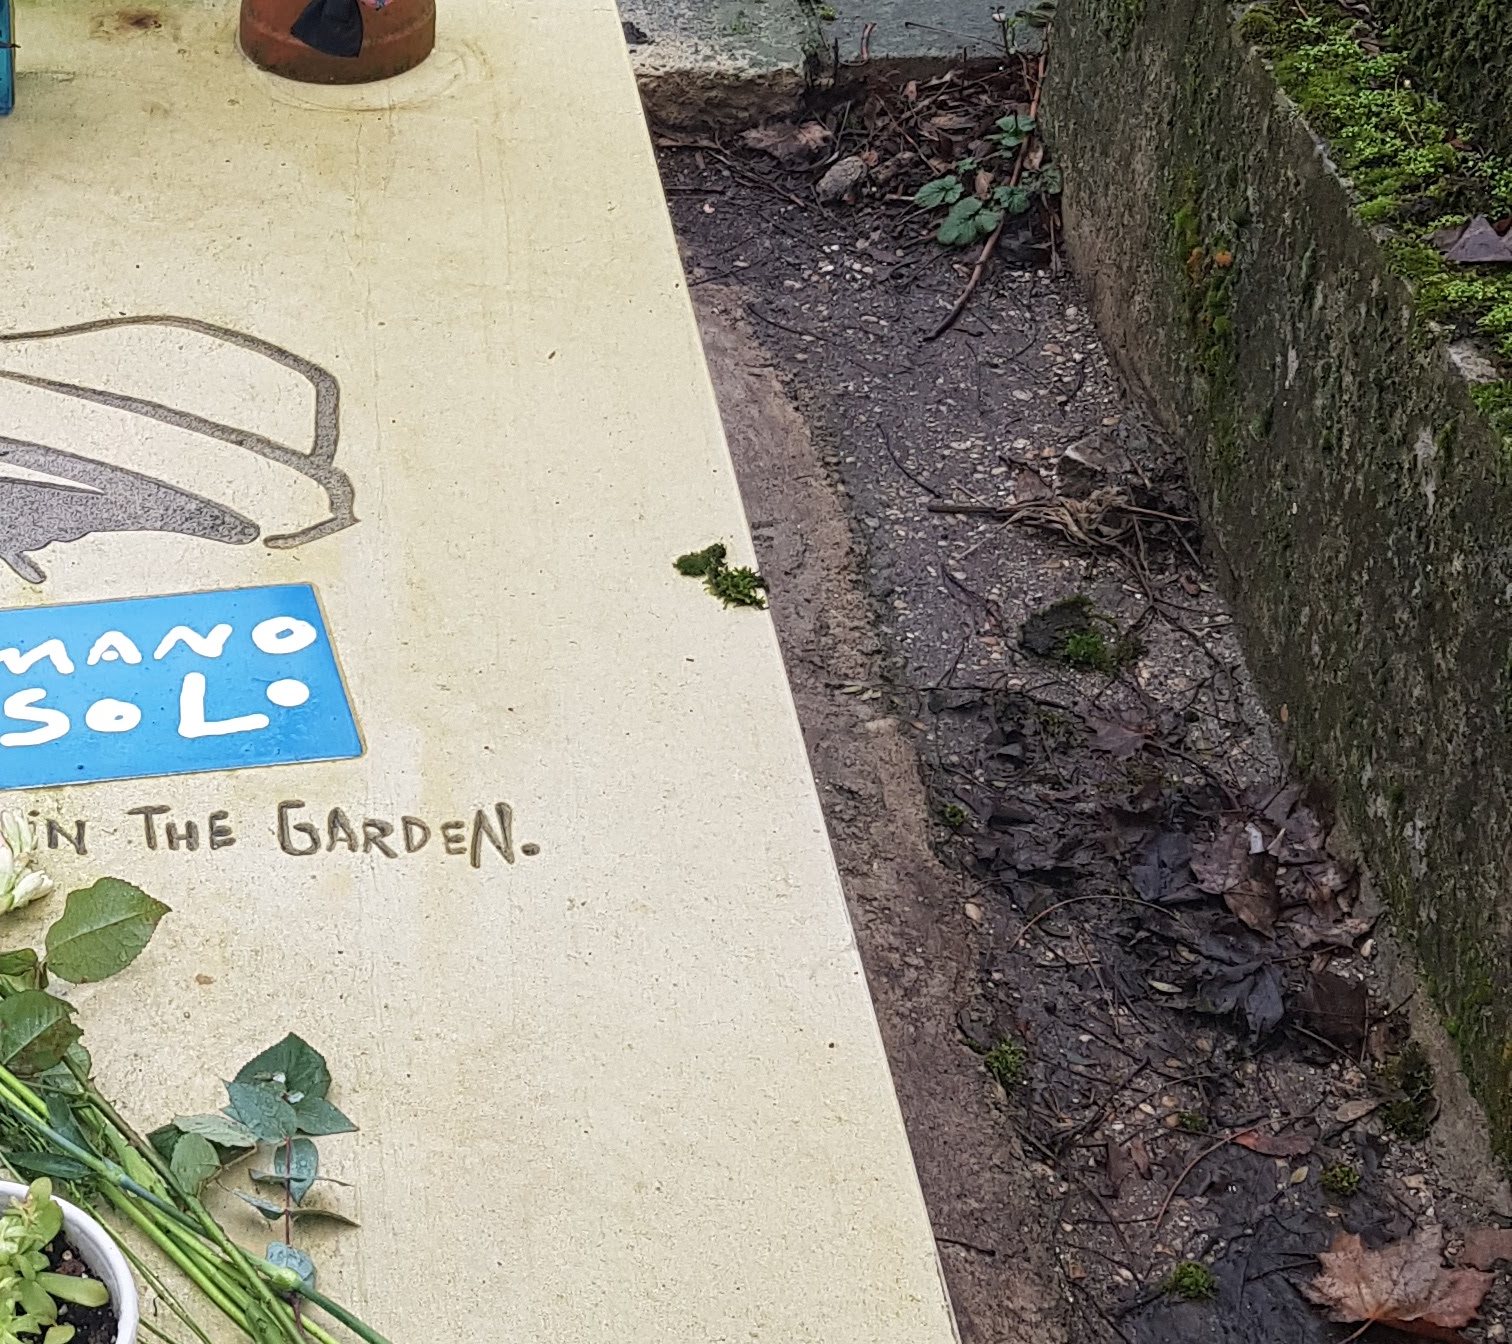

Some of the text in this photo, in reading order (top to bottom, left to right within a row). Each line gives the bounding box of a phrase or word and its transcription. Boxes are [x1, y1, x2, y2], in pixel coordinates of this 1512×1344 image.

[0, 671, 311, 748] SOLO
[127, 804, 237, 852] THE
[276, 799, 541, 869] GARDEN.
